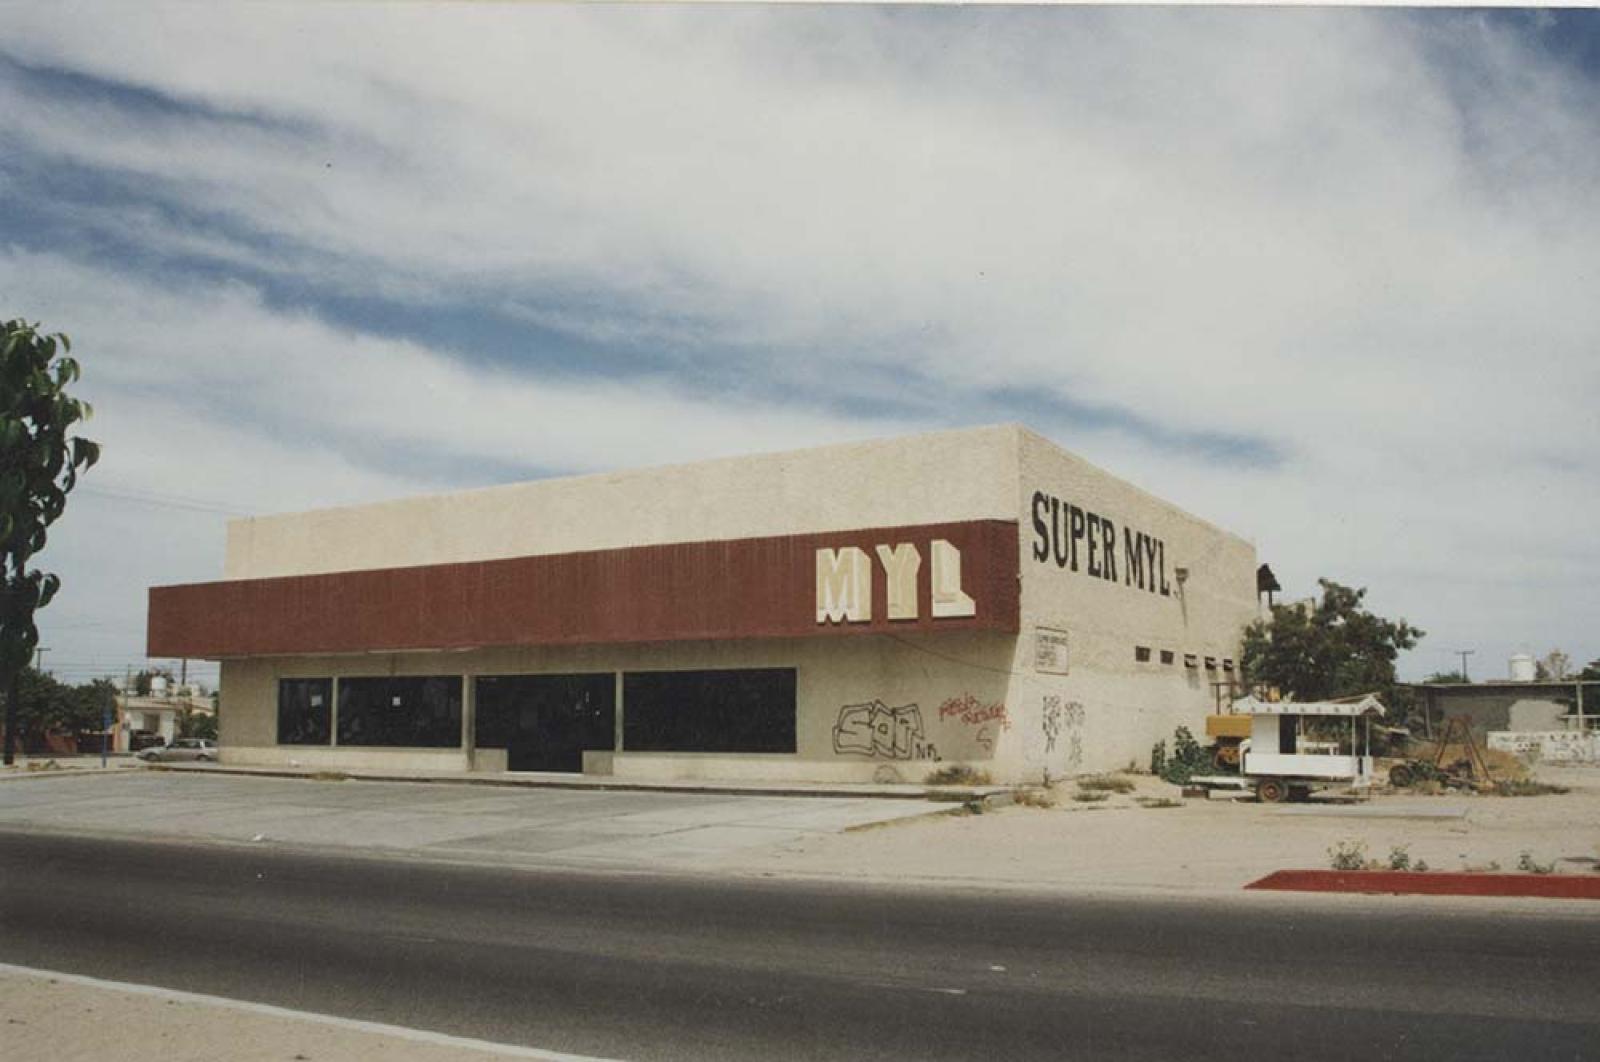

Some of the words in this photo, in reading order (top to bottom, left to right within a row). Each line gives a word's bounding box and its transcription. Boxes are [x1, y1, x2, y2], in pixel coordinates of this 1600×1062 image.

[815, 538, 976, 623] MYL
[1031, 490, 1118, 583] SUPER
[1124, 525, 1171, 597] MYL
